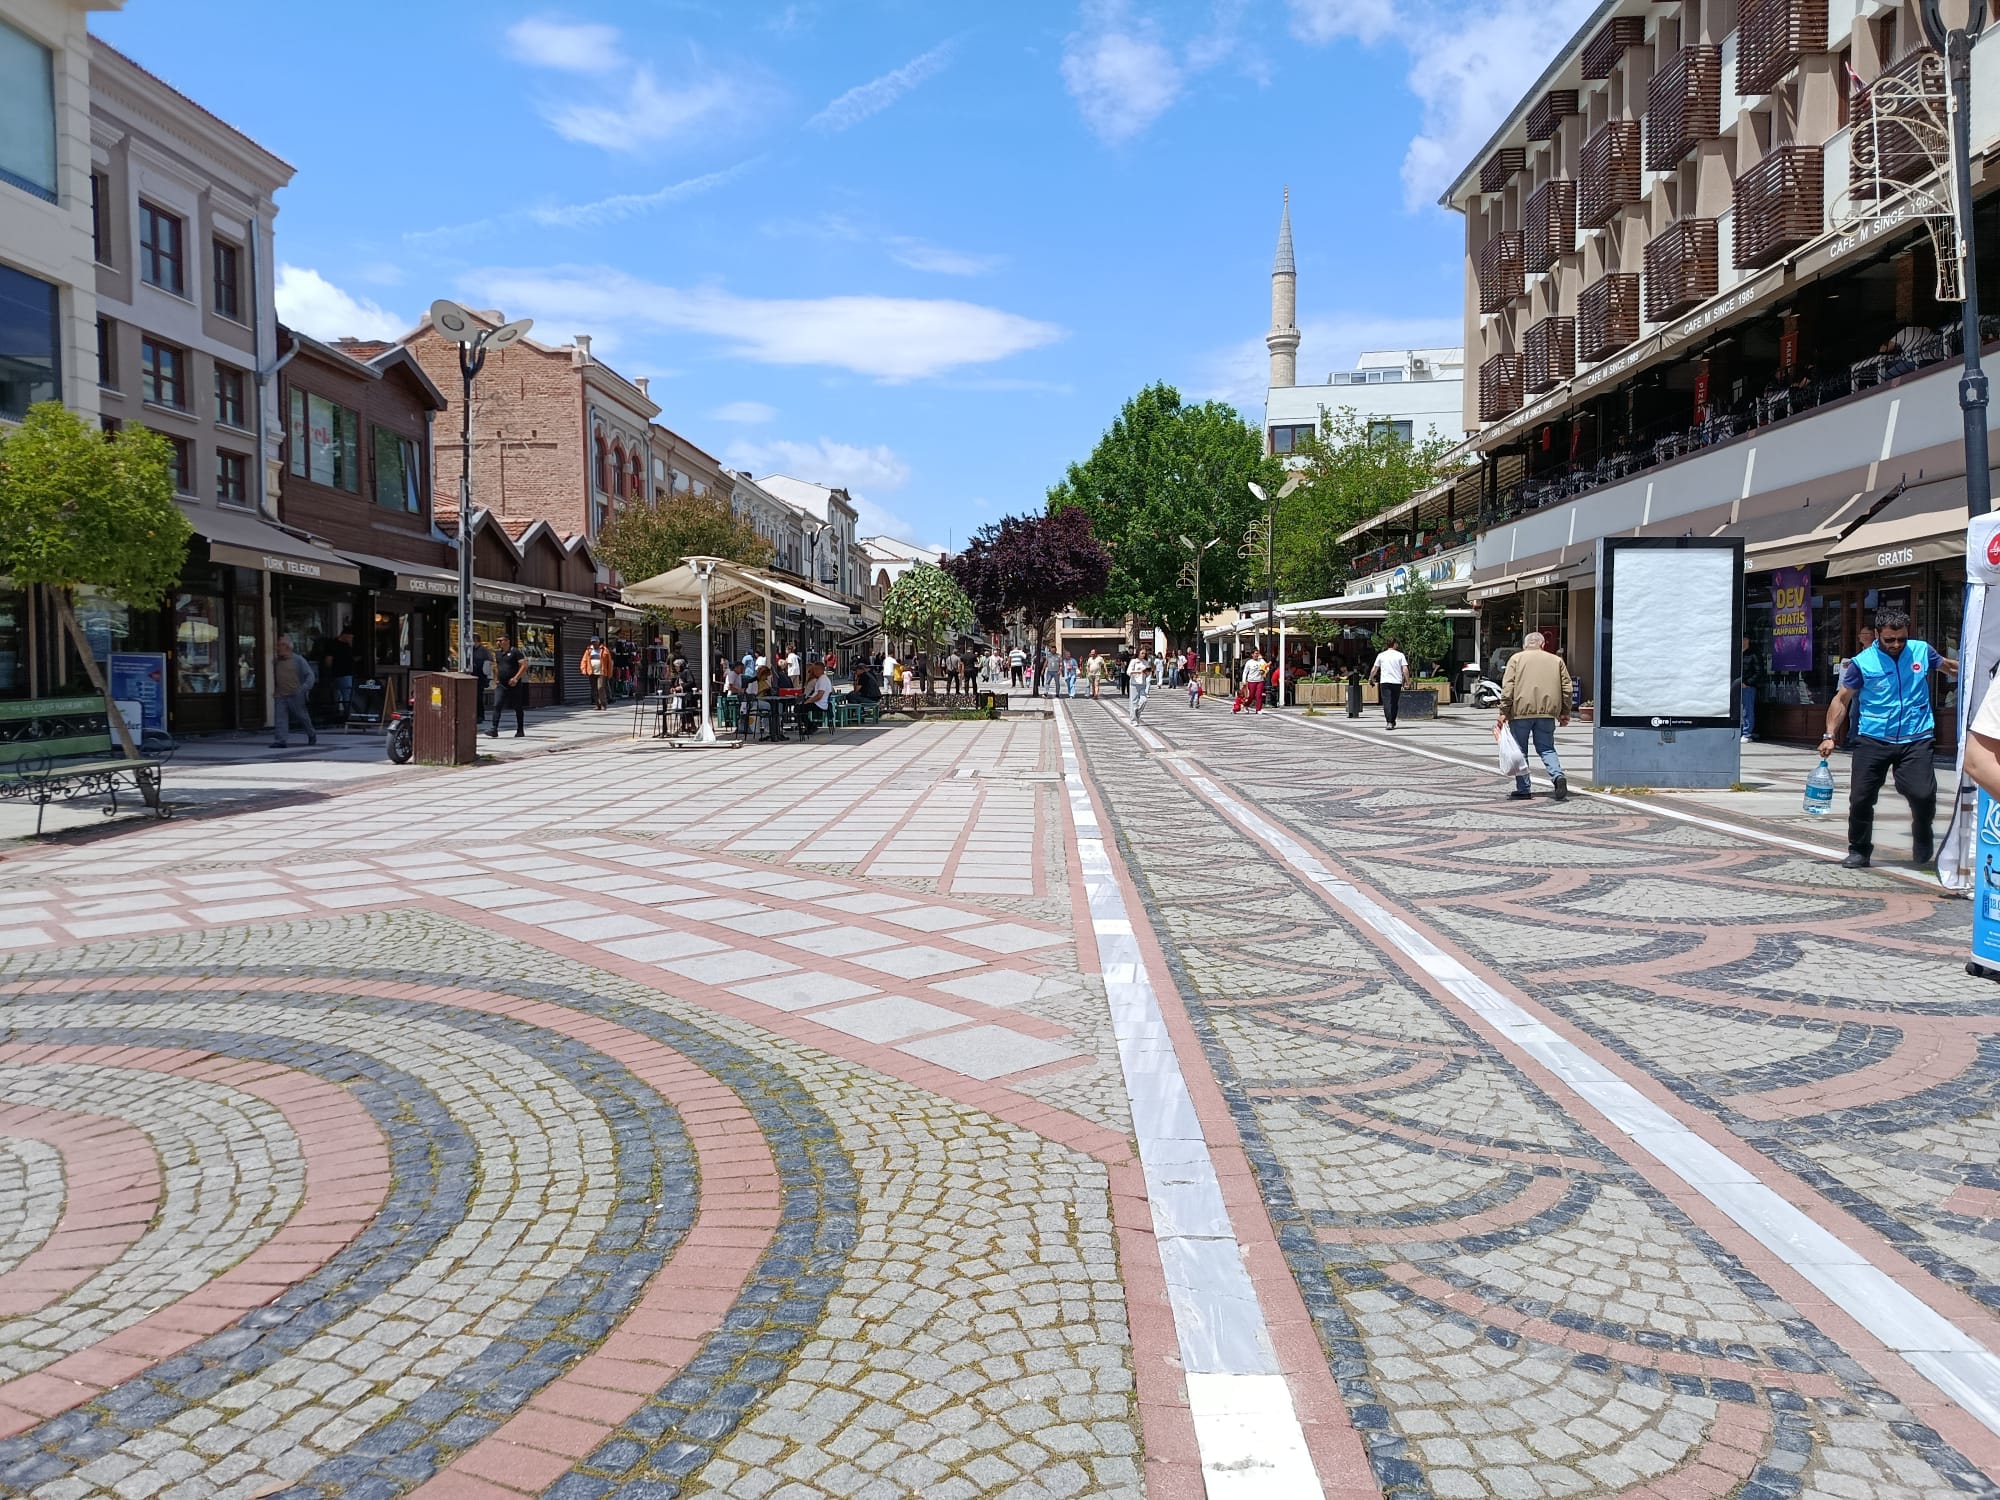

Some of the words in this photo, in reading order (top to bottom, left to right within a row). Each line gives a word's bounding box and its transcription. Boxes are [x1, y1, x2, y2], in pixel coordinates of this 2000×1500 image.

[1830, 237, 1855, 257] CAFE
[1860, 228, 1868, 240] M
[1874, 206, 1905, 234] SINCE
[1684, 317, 1702, 335] CAFE
[1704, 312, 1711, 324] M
[1713, 298, 1735, 318] SINCE
[1738, 287, 1754, 305] 1985
[263, 556, 284, 571] TÜRK
[287, 561, 321, 577] TELEKOM
[1744, 560, 1753, 569] TİS
[1877, 548, 1913, 566] GRATİS
[1776, 586, 1805, 609] DEV
[1775, 610, 1806, 626] GRATİS
[1773, 626, 1808, 636] KAMPANYASI
